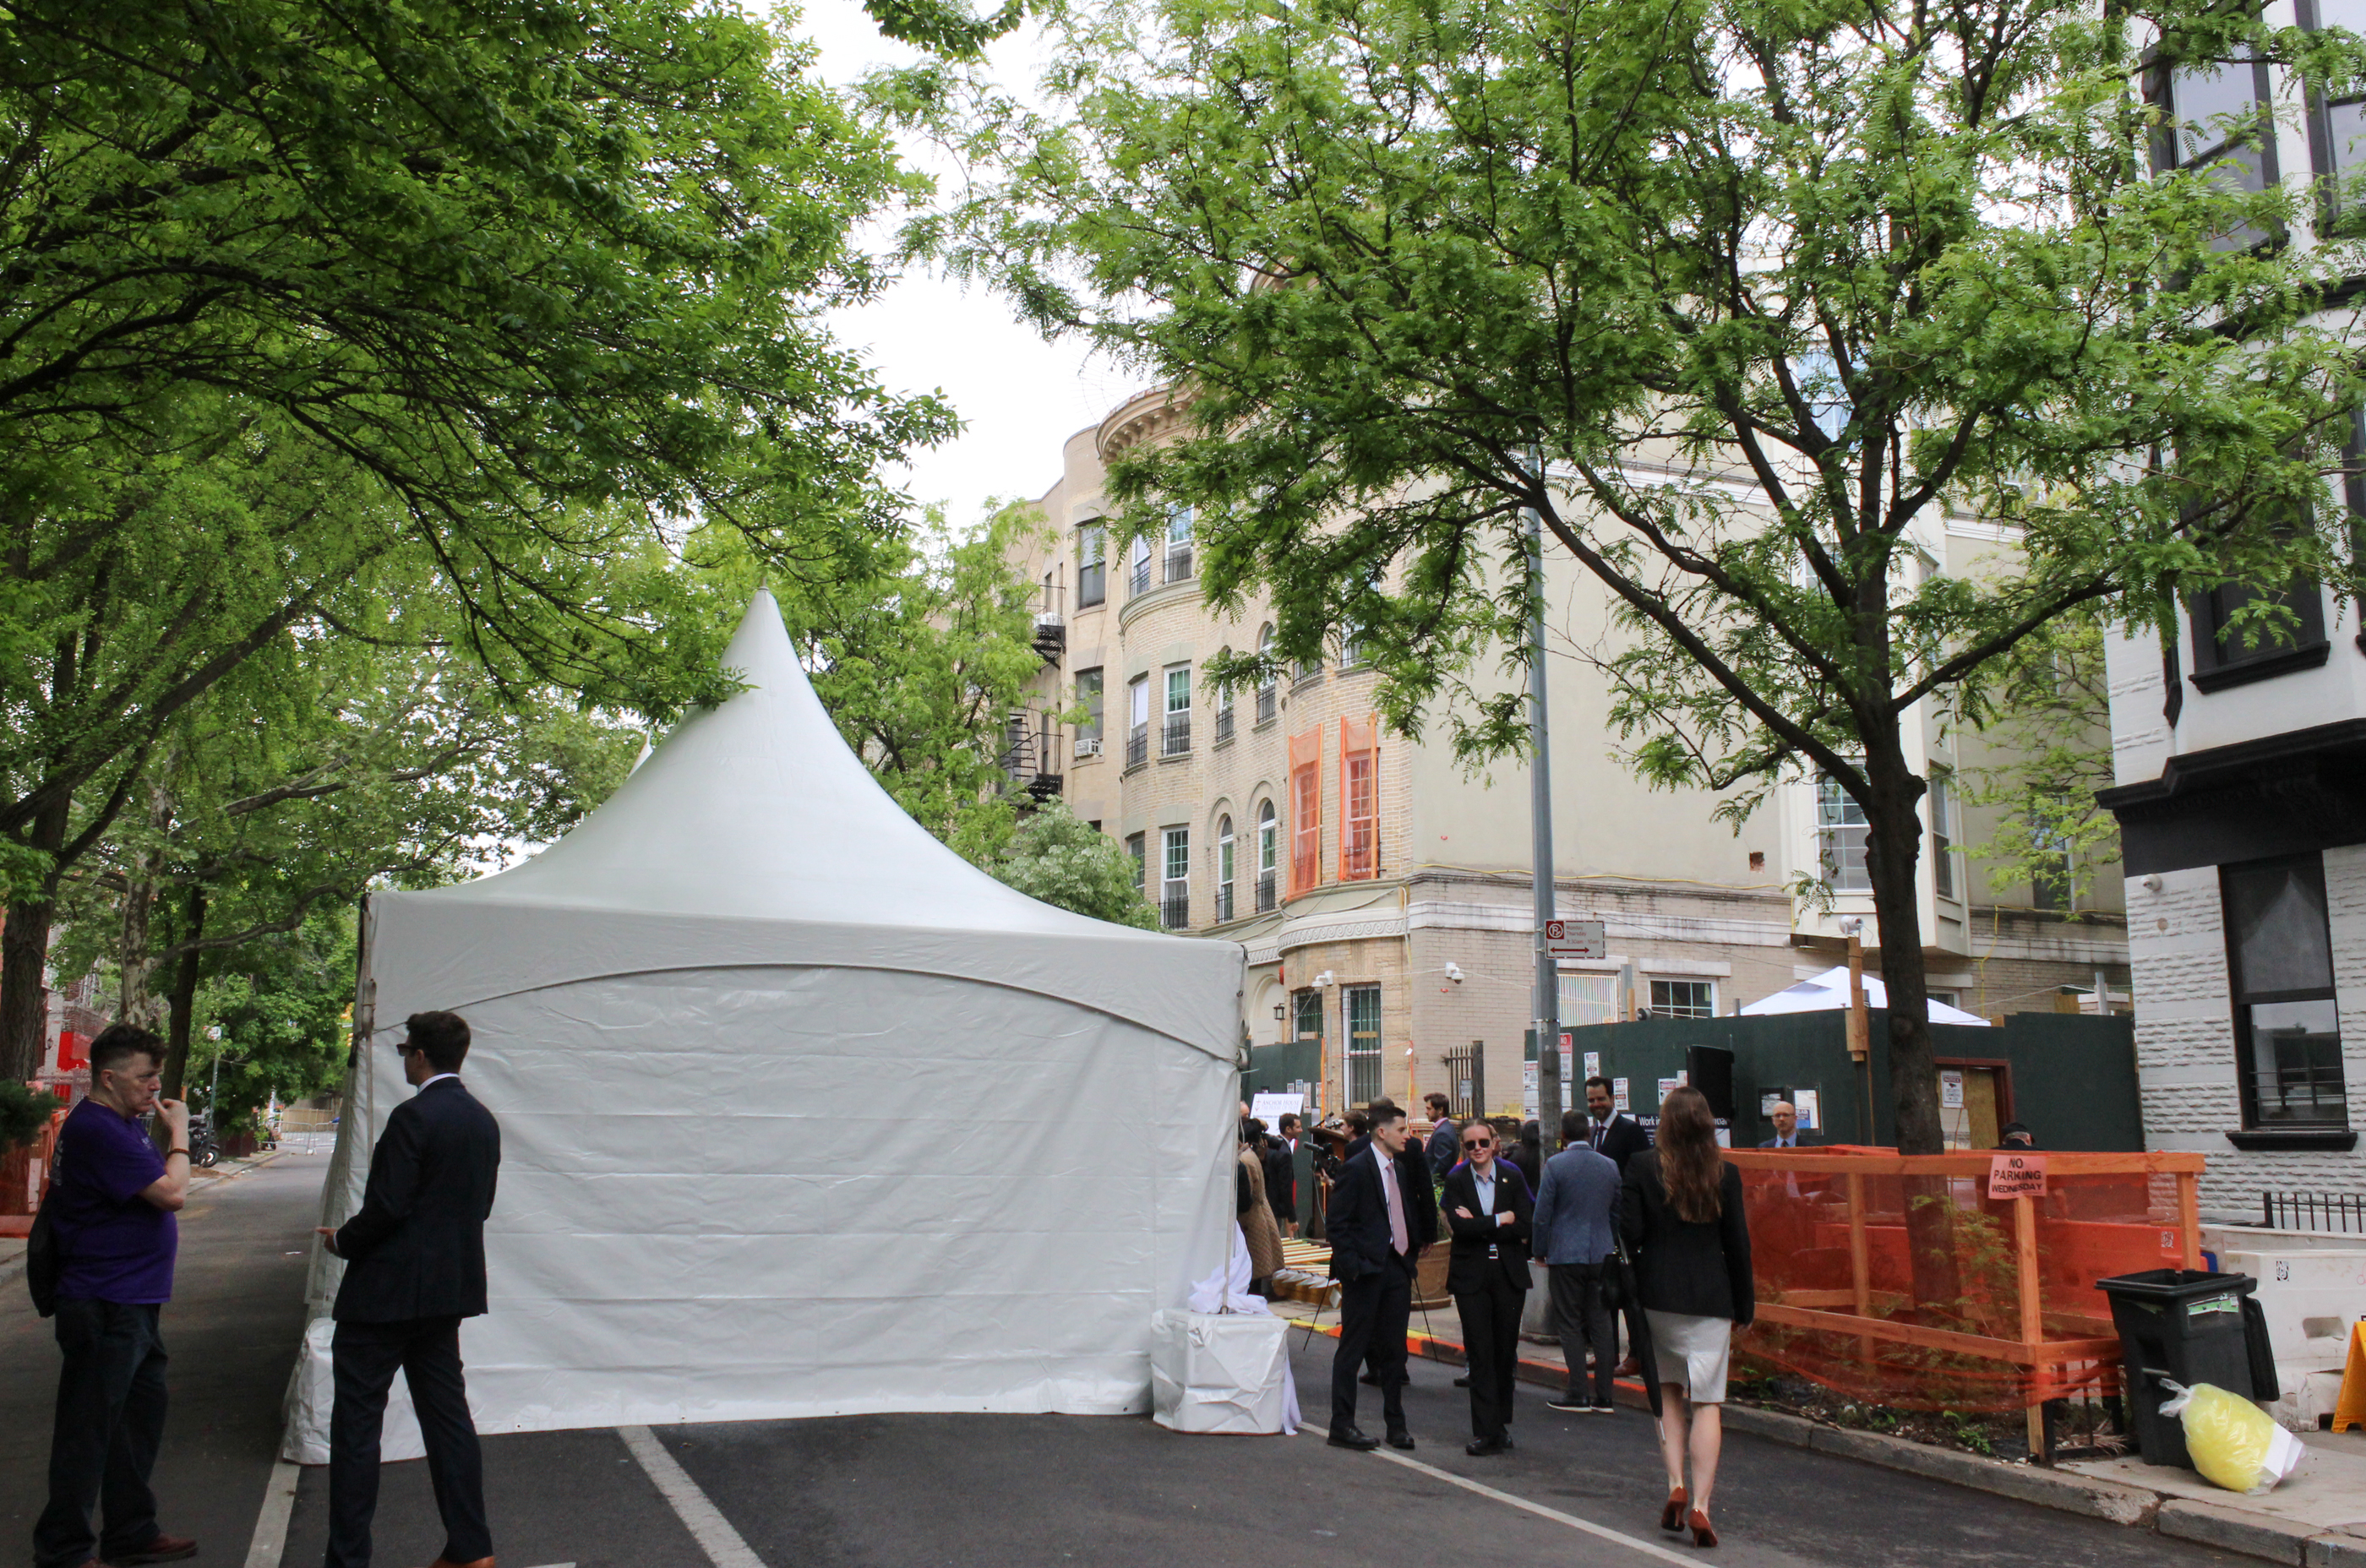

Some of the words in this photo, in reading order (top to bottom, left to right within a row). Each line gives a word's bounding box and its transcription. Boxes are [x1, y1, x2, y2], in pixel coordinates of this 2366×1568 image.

[1560, 1036, 1567, 1045] NO
[1639, 1116, 1654, 1126] Work
[2009, 1157, 2024, 1168] NO
[1994, 1169, 2042, 1181] PARKING
[1992, 1183, 2042, 1193] WEDNESDAY
